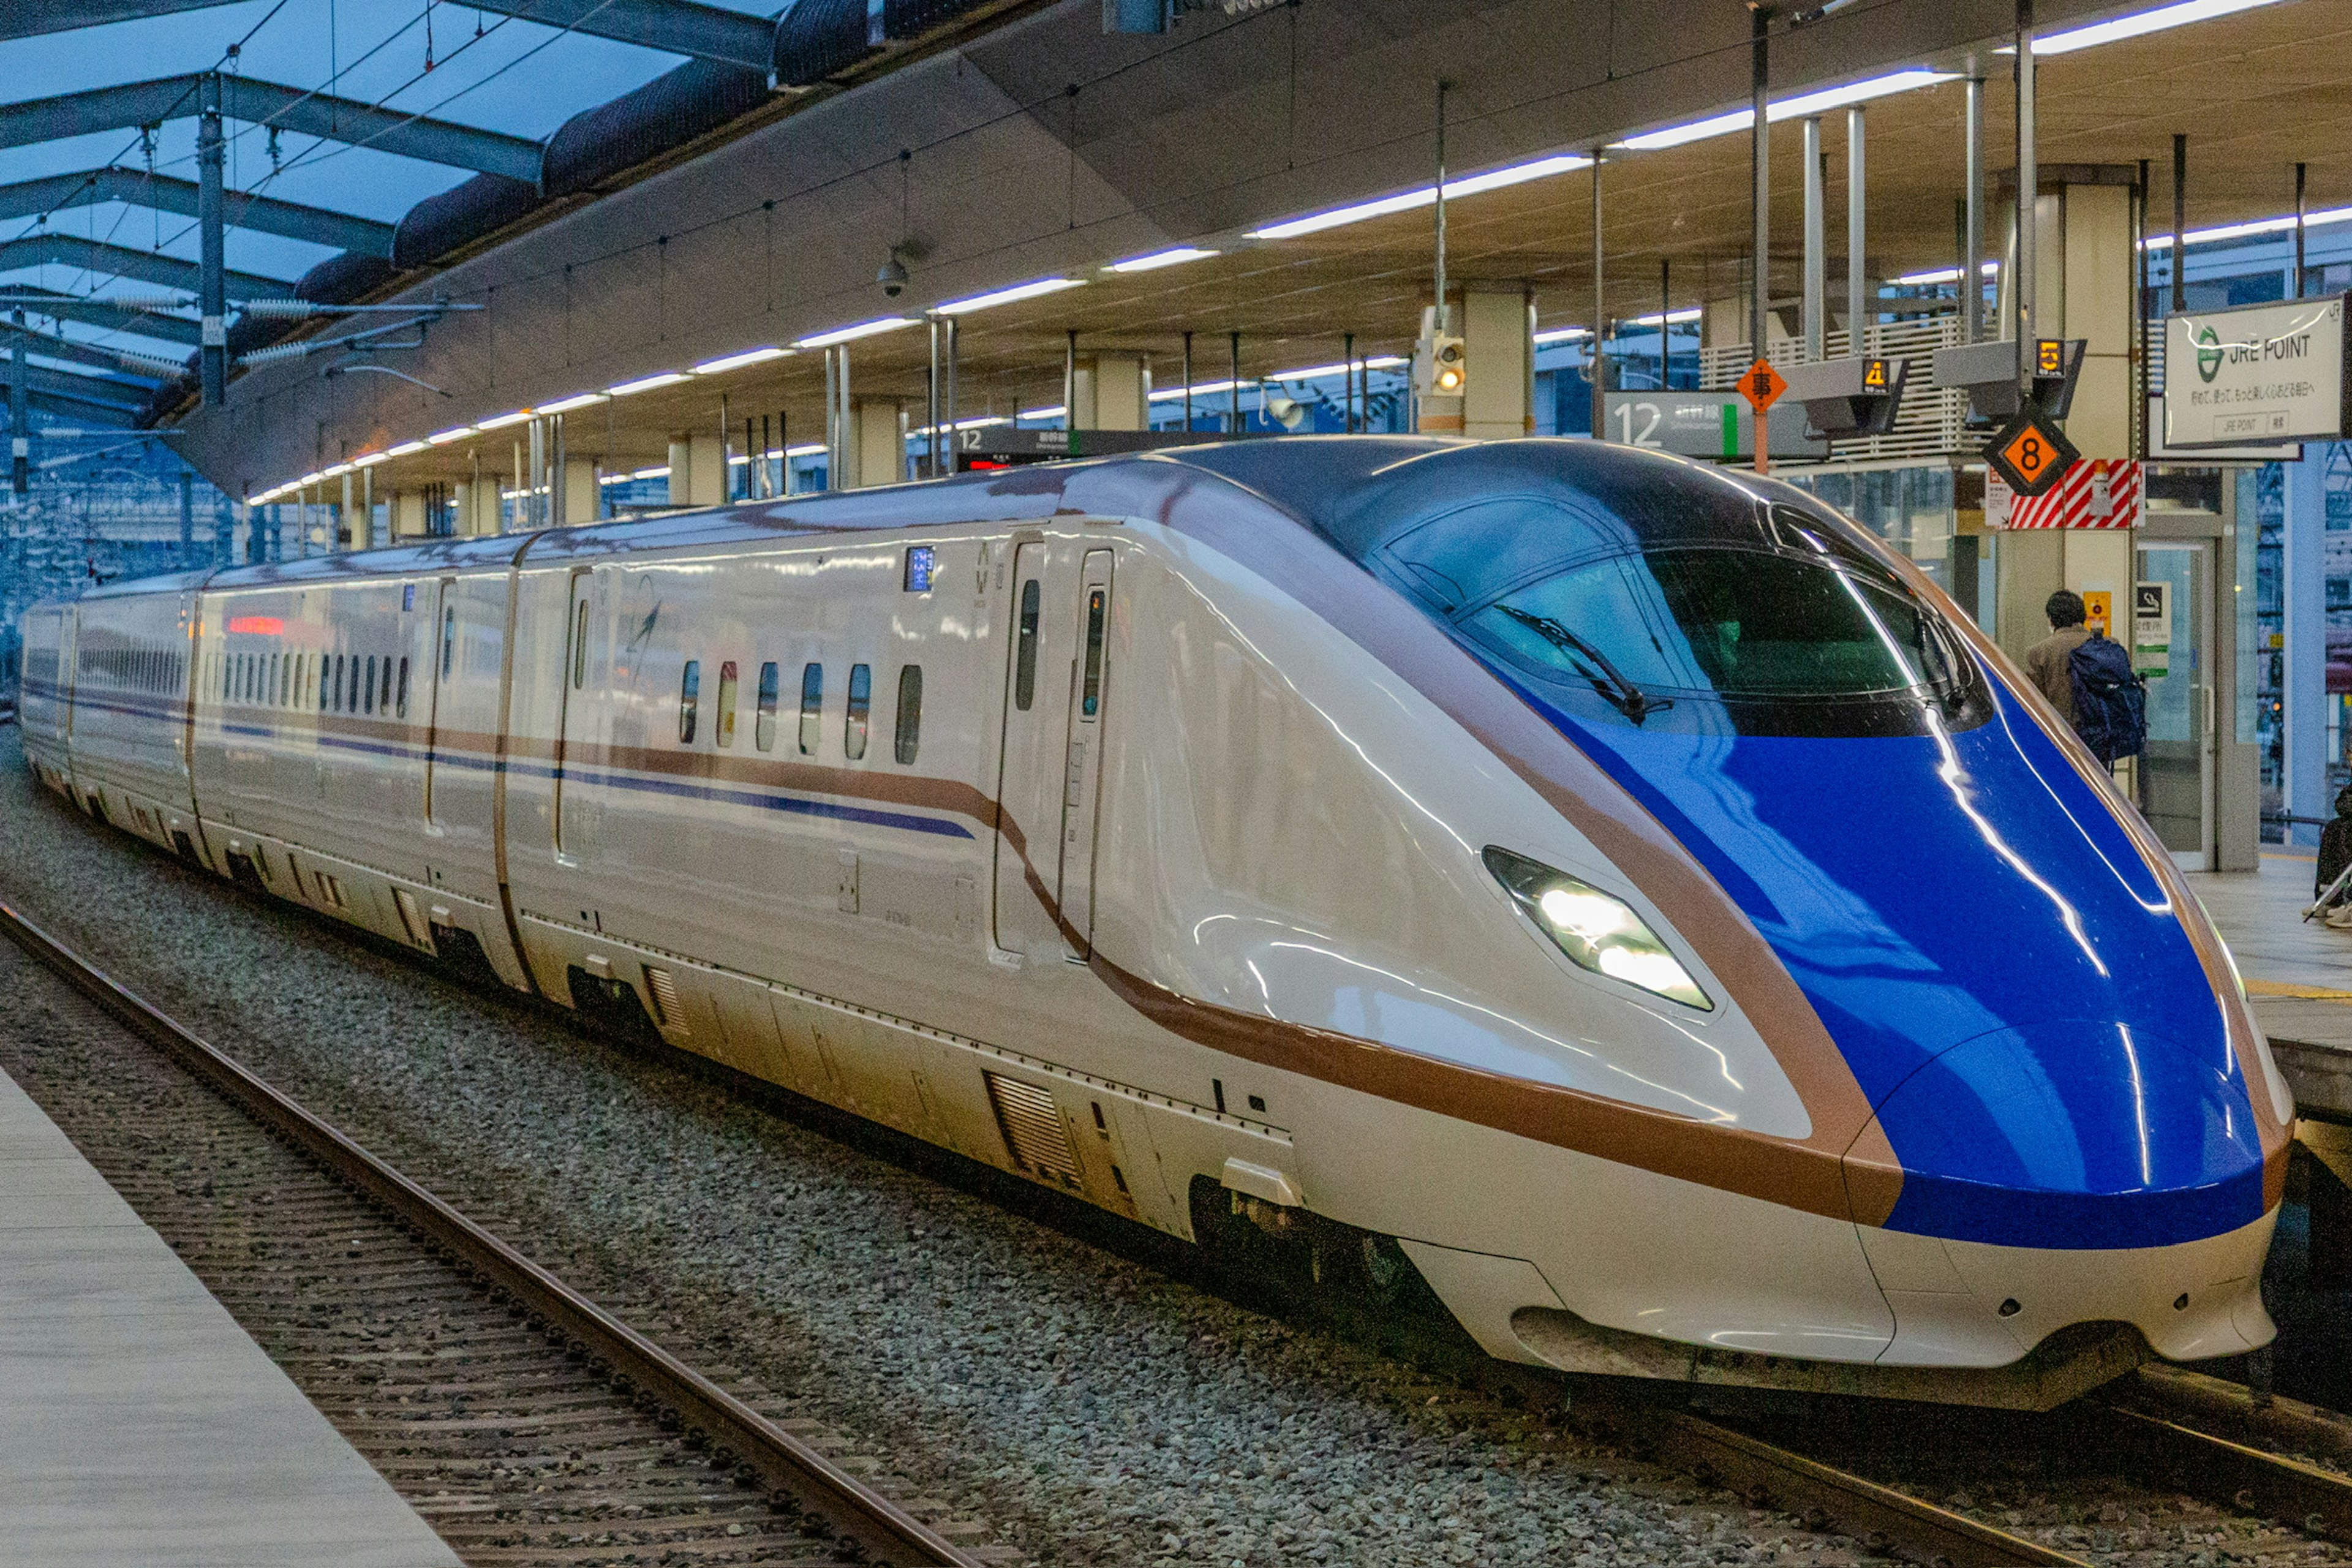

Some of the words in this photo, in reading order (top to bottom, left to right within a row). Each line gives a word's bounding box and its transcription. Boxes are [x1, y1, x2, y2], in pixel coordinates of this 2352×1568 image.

[2329, 303, 2340, 317] JR
[2041, 342, 2059, 371] 5
[2230, 339, 2259, 364] JRE
[2264, 335, 2310, 360] POINT
[1866, 361, 1885, 385] 4
[1614, 402, 1662, 447] 12
[959, 430, 982, 450] 12
[2021, 438, 2040, 471] 8
